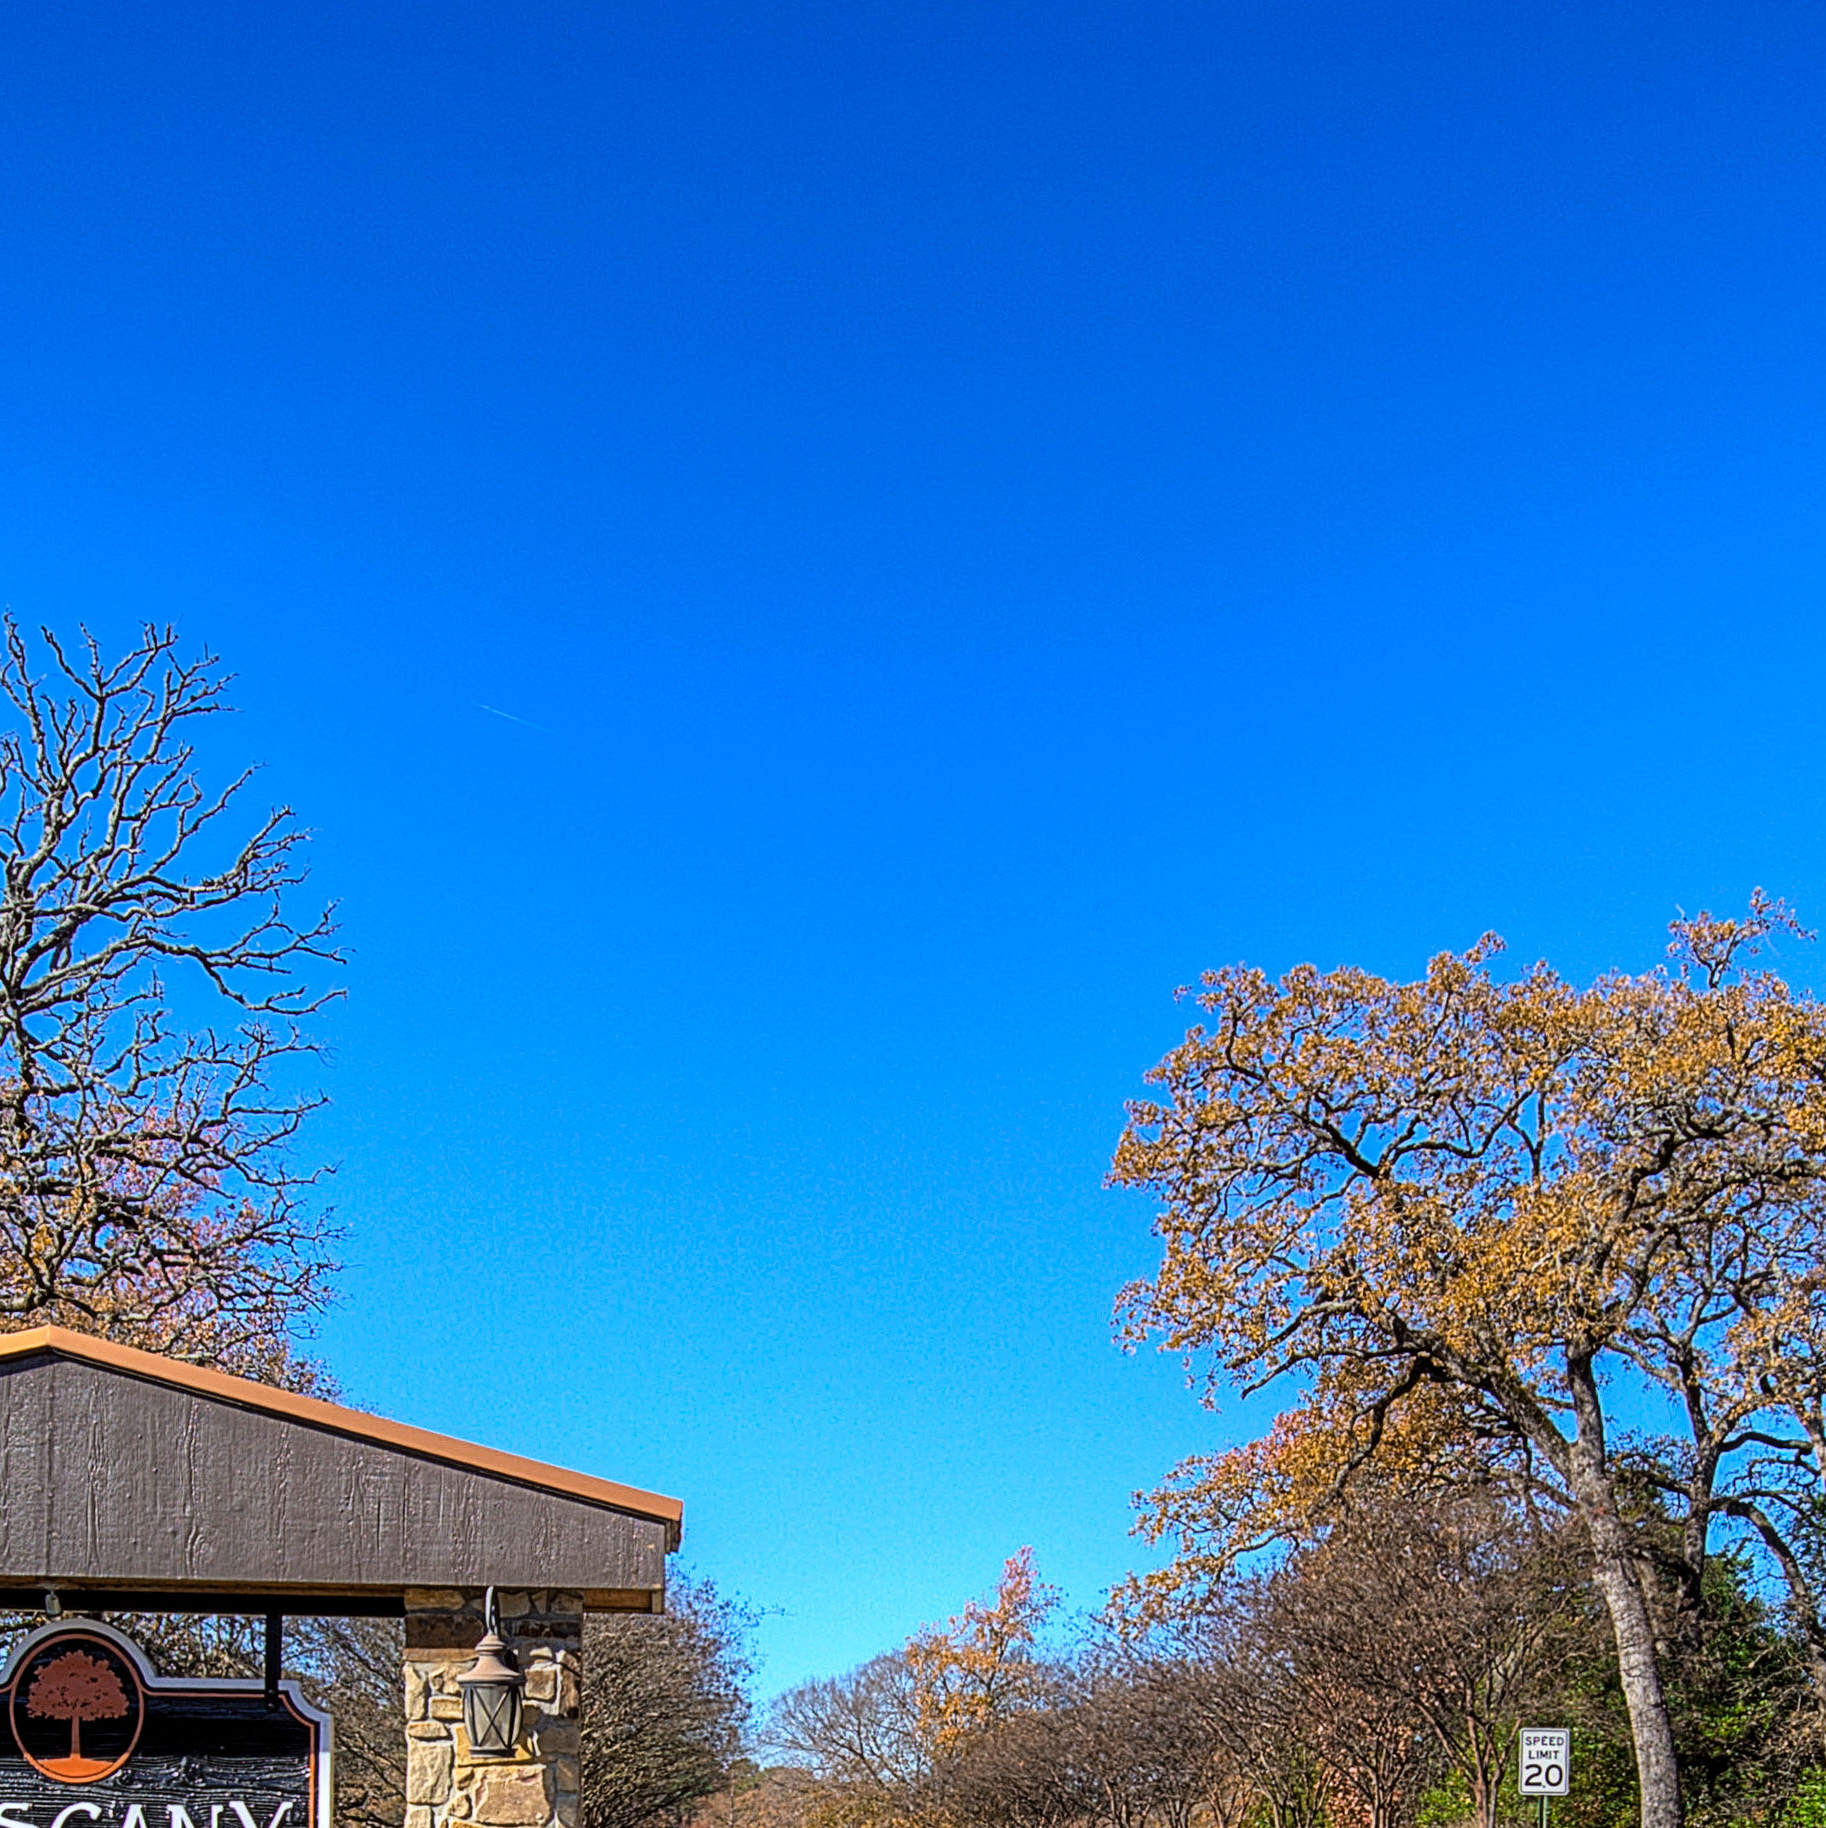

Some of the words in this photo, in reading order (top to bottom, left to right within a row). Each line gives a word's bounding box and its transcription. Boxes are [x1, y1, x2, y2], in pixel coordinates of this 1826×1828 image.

[1525, 1736, 1564, 1746] SPEED
[1528, 1750, 1559, 1759] LIMIT
[1524, 1764, 1563, 1786] 20
